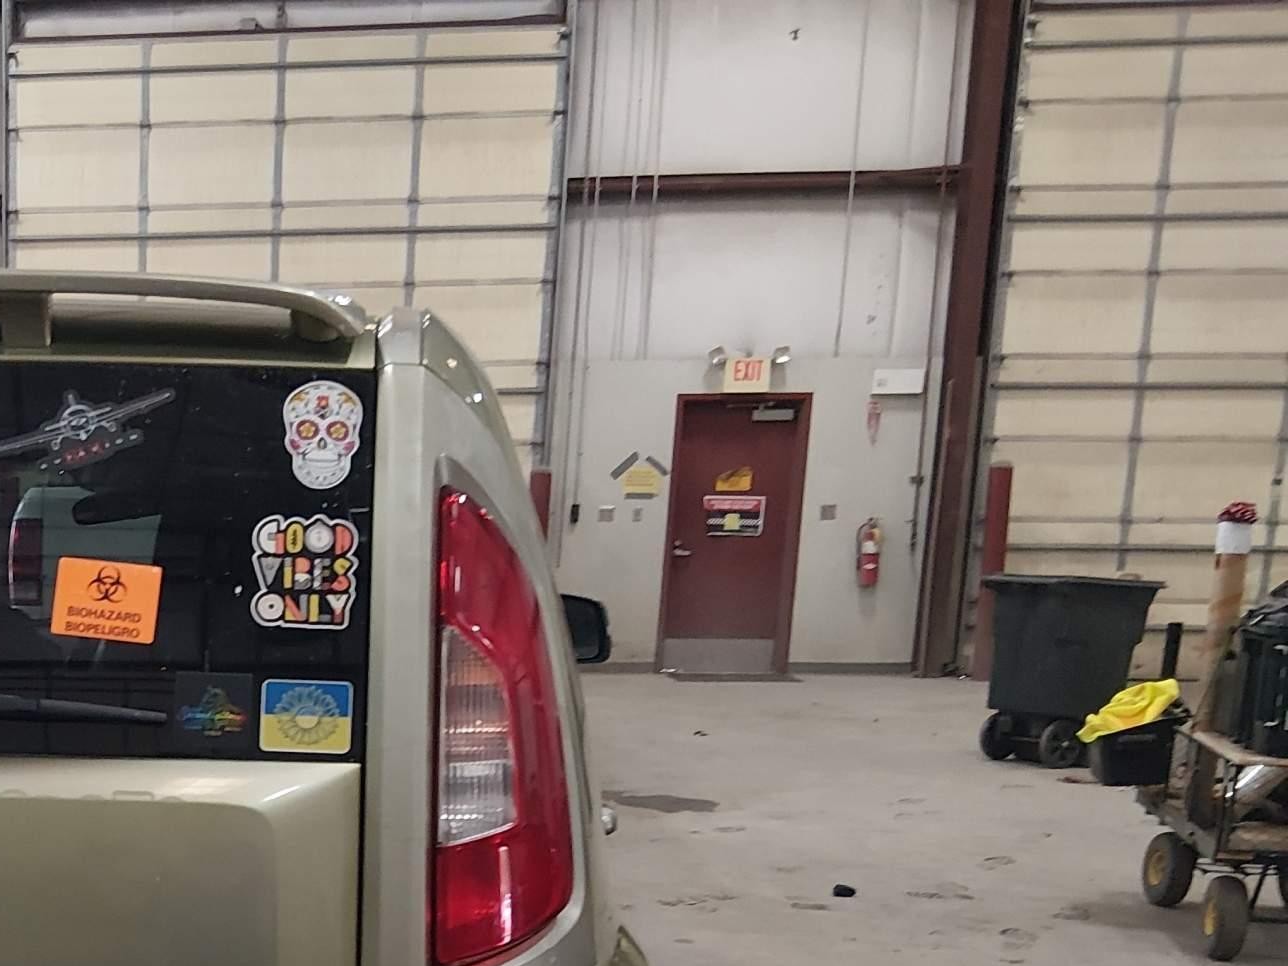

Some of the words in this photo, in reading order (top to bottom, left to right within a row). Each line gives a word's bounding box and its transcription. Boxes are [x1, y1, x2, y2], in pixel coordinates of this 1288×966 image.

[733, 359, 764, 381] EXIT
[257, 520, 354, 555] GOOD
[257, 556, 352, 591] VIBES
[66, 606, 142, 624] BIOHAZARD
[255, 592, 350, 623] ONLY
[64, 621, 141, 639] BIOPELIGRO
